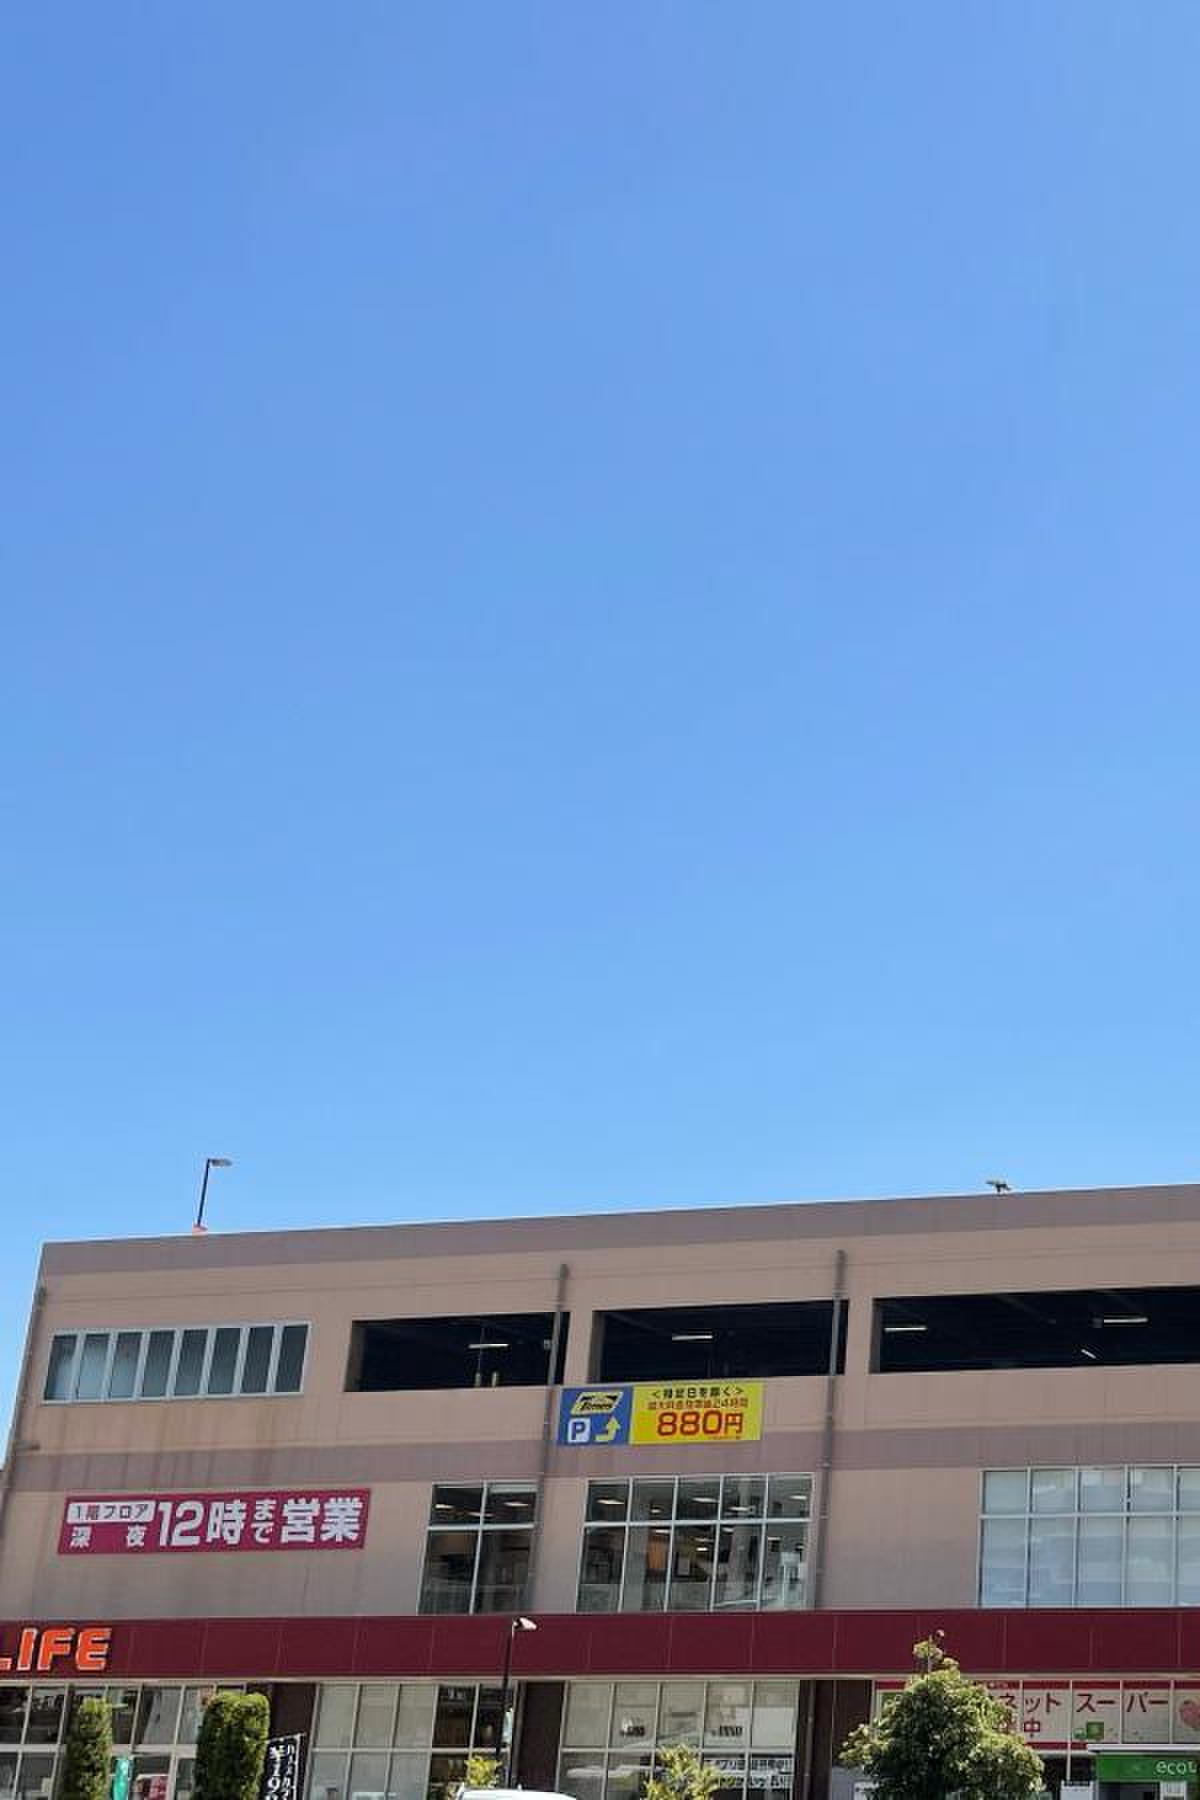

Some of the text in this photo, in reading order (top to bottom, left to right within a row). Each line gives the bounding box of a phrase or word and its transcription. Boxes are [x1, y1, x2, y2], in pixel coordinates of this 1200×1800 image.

[571, 1421, 586, 1438] P
[656, 1410, 744, 1435] 880円
[76, 1504, 149, 1520] 1階フロア
[157, 1497, 363, 1547] 12時まで営業
